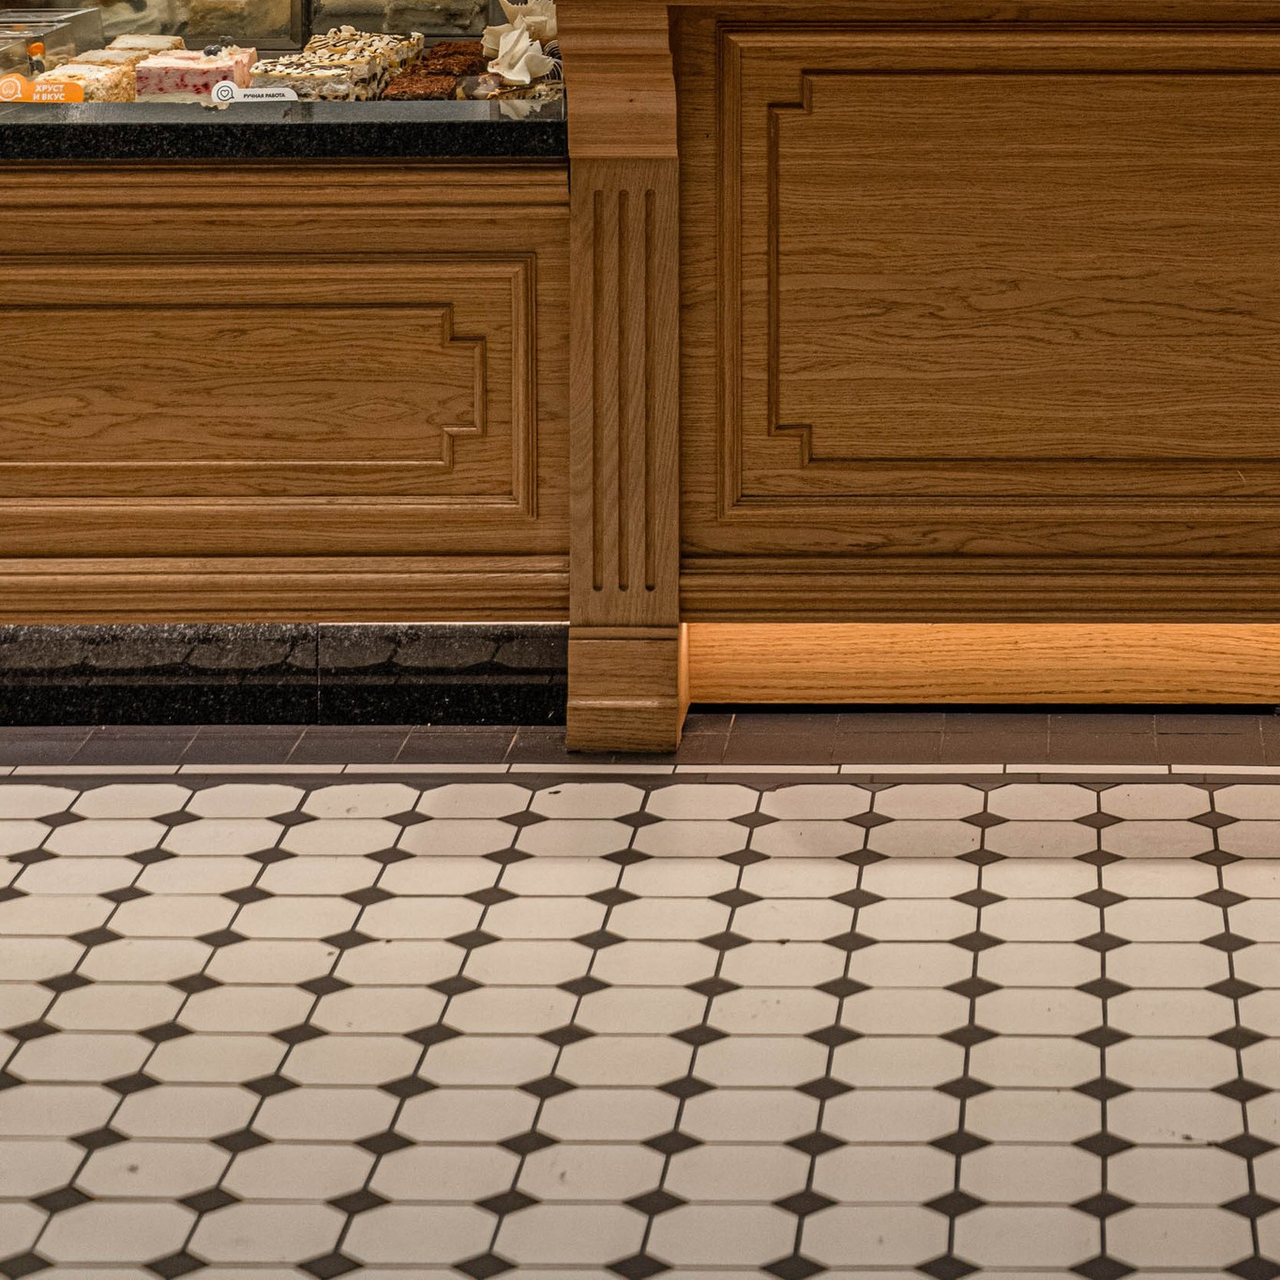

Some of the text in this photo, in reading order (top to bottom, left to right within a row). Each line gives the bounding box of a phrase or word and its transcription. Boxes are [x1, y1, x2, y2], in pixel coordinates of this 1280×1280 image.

[35, 84, 64, 92] ХРУСТ
[33, 93, 65, 101] И ВКУС
